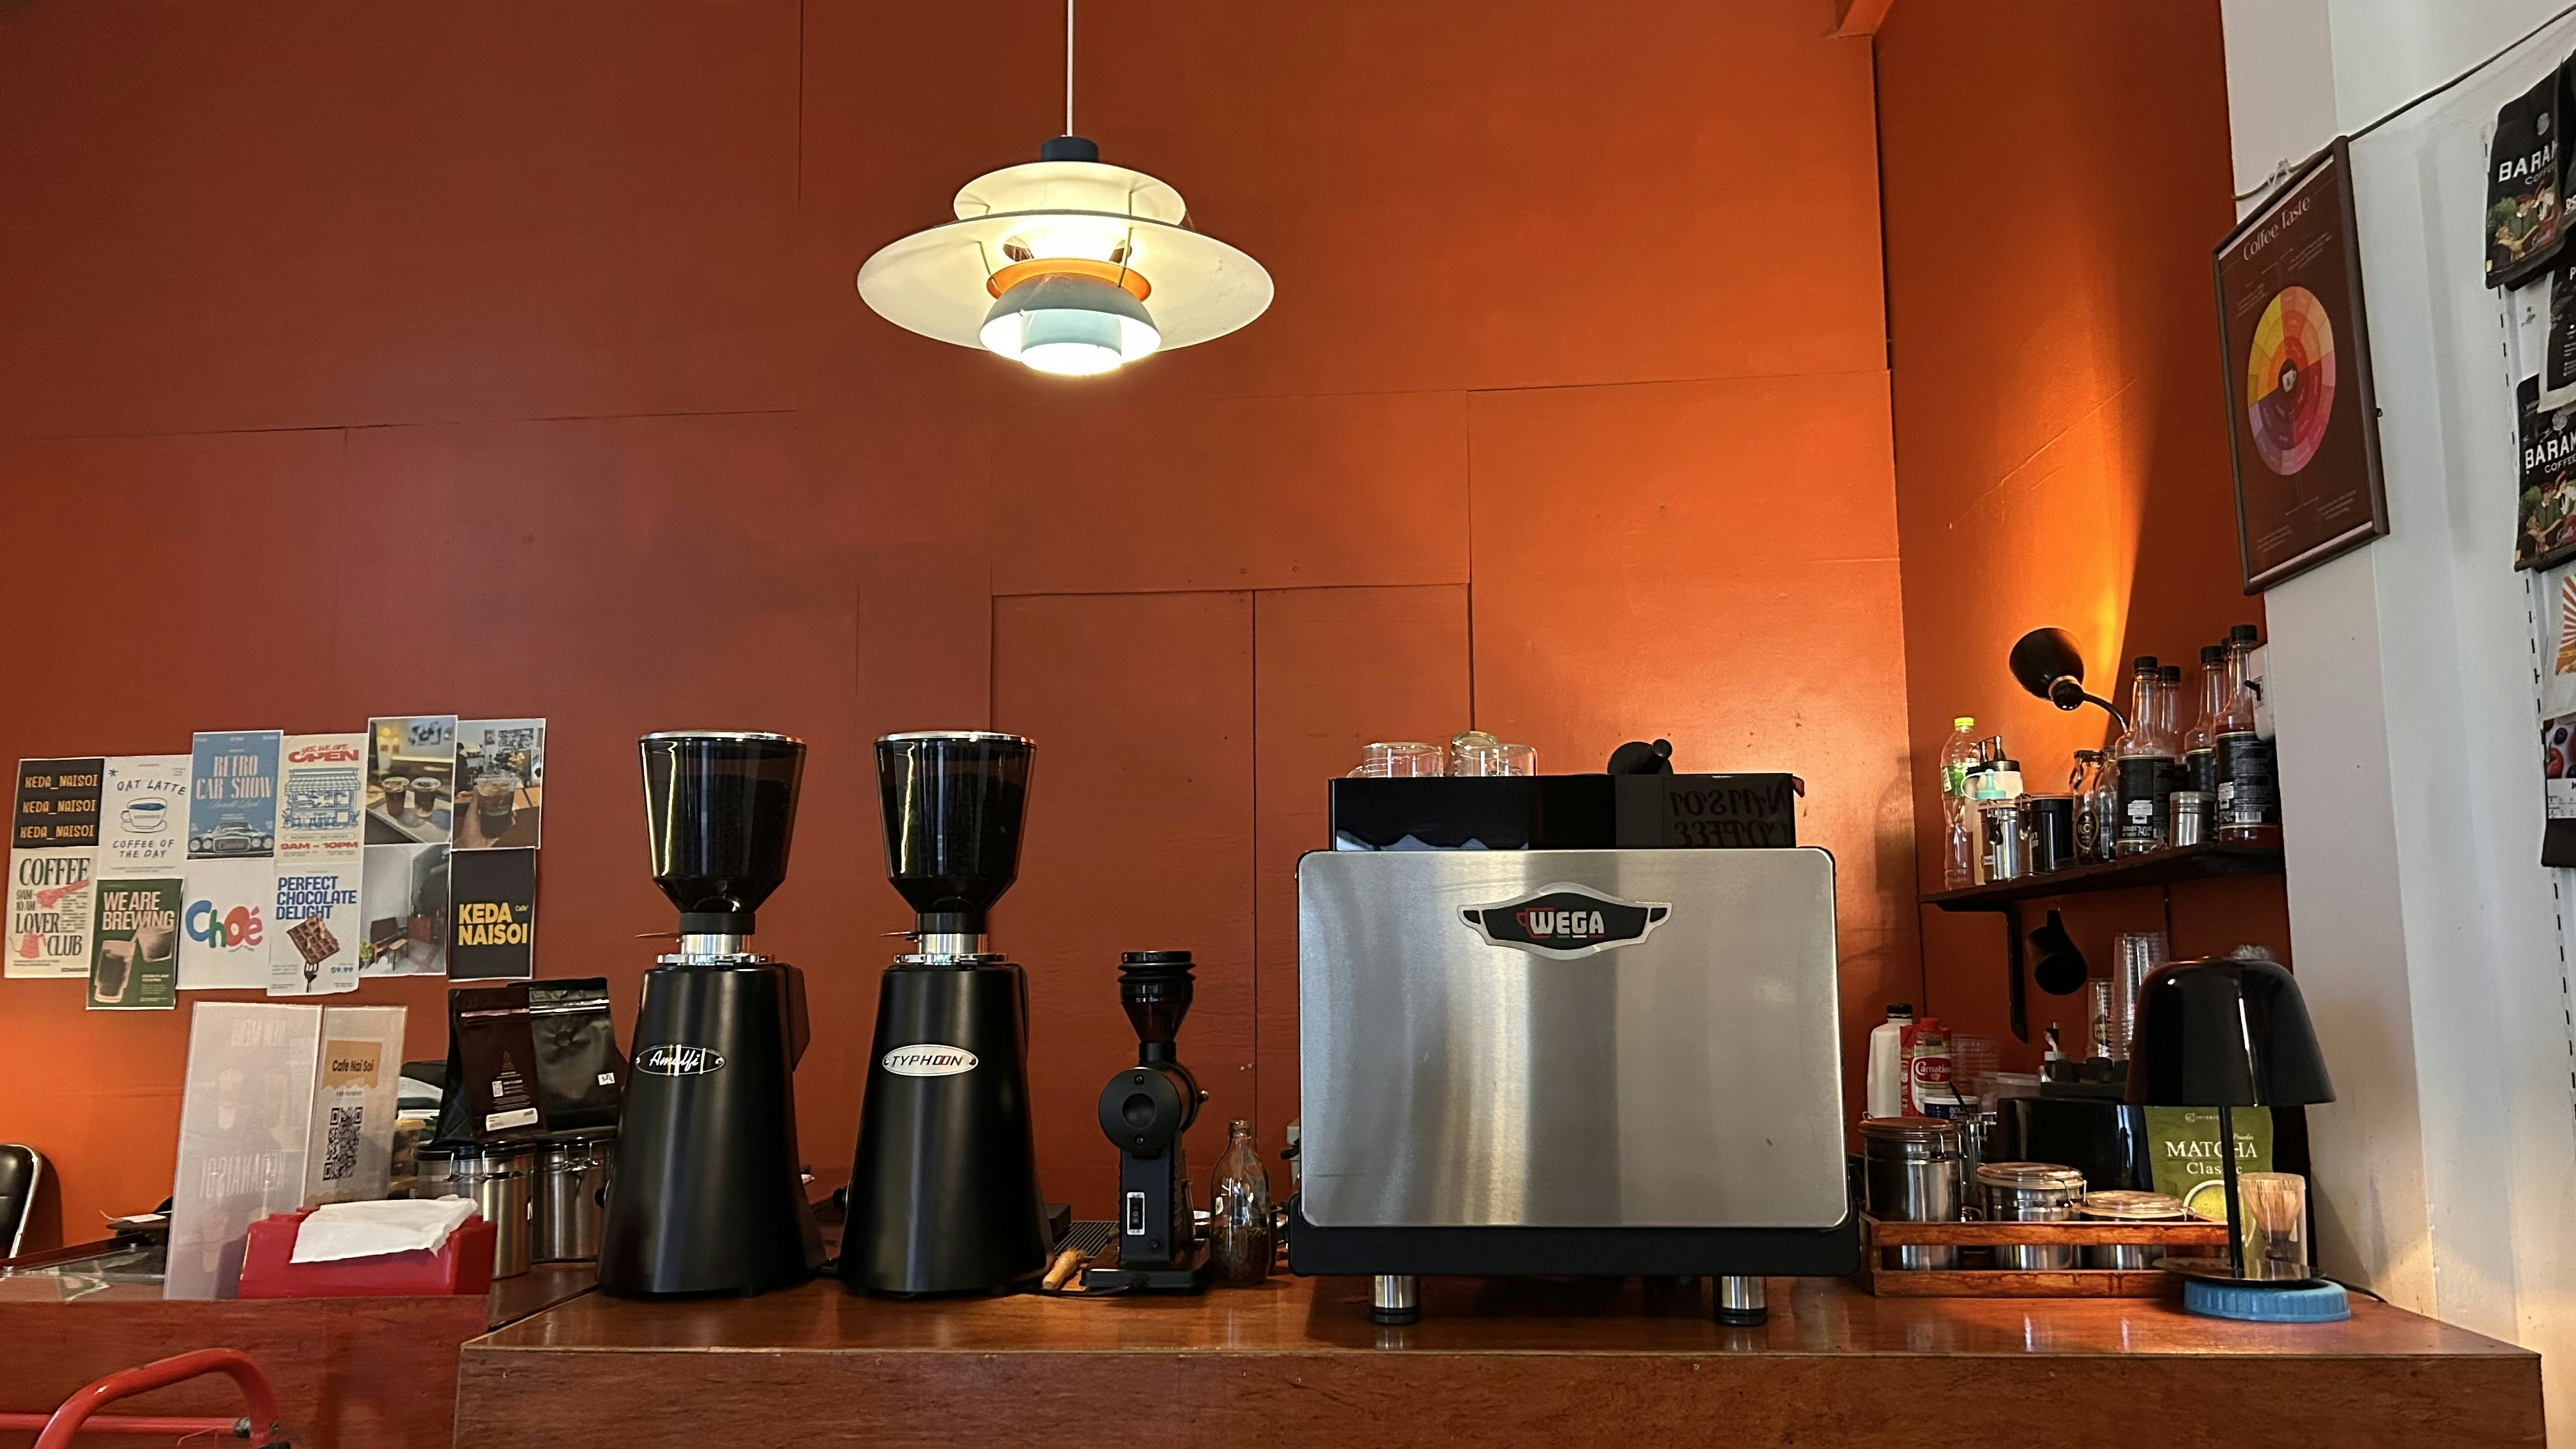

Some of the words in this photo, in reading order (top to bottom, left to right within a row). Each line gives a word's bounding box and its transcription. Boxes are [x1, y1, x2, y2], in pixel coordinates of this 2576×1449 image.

[2244, 224, 2278, 261] Coffee
[2281, 197, 2310, 229] Taste
[288, 749, 359, 763] OPEN
[213, 755, 259, 778] RETRO
[117, 779, 142, 792] OAT
[148, 779, 187, 795] LATTE
[195, 778, 224, 800] CAR
[231, 776, 274, 799] SHOW
[113, 839, 155, 848] COFFEE
[160, 839, 174, 848] OF
[119, 850, 139, 858] THE
[144, 850, 167, 858] DAY
[19, 857, 91, 885] COFFEE
[278, 876, 338, 891] PERFECT
[103, 891, 128, 911] WE
[128, 891, 161, 910] ARE
[277, 890, 357, 905] CHOCOLATE
[15, 912, 60, 933] LOVER
[102, 910, 175, 930] BREWING
[276, 905, 333, 920] DELIGHT
[459, 901, 512, 924] KEDA
[1529, 910, 1605, 934] WEGA
[458, 923, 528, 946] NAISOI
[47, 935, 82, 956] CLUB
[332, 1059, 349, 1071] Cafe
[350, 1059, 363, 1071] Nai
[363, 1059, 375, 1071] Soi
[649, 1049, 701, 1071] Amalfi
[892, 1055, 963, 1066] TYPHOON
[2187, 1162, 2242, 1174] Clasc
